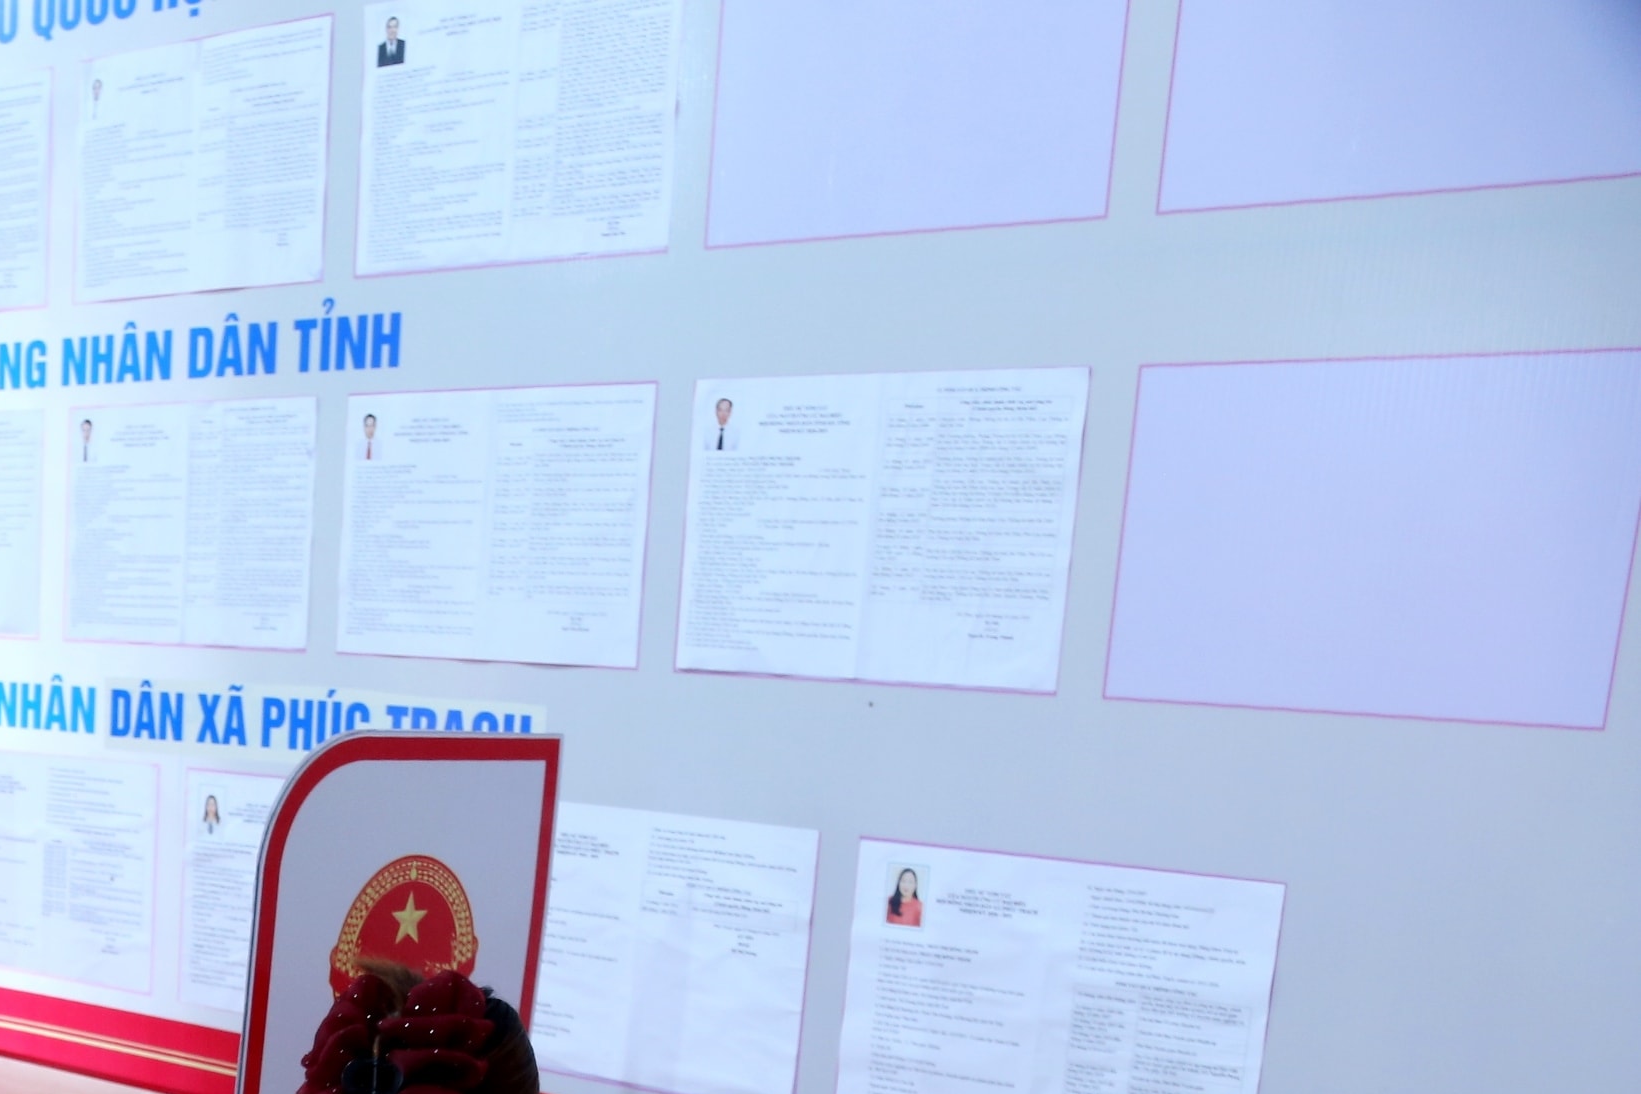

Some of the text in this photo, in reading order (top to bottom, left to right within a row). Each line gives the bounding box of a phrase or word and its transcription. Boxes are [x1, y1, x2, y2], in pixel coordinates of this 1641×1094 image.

[61, 321, 172, 386] NHÂN
[188, 313, 278, 378] DÂN
[294, 297, 401, 373] TỈNH
[109, 680, 184, 742] DÂN
[197, 685, 247, 746] XÃ
